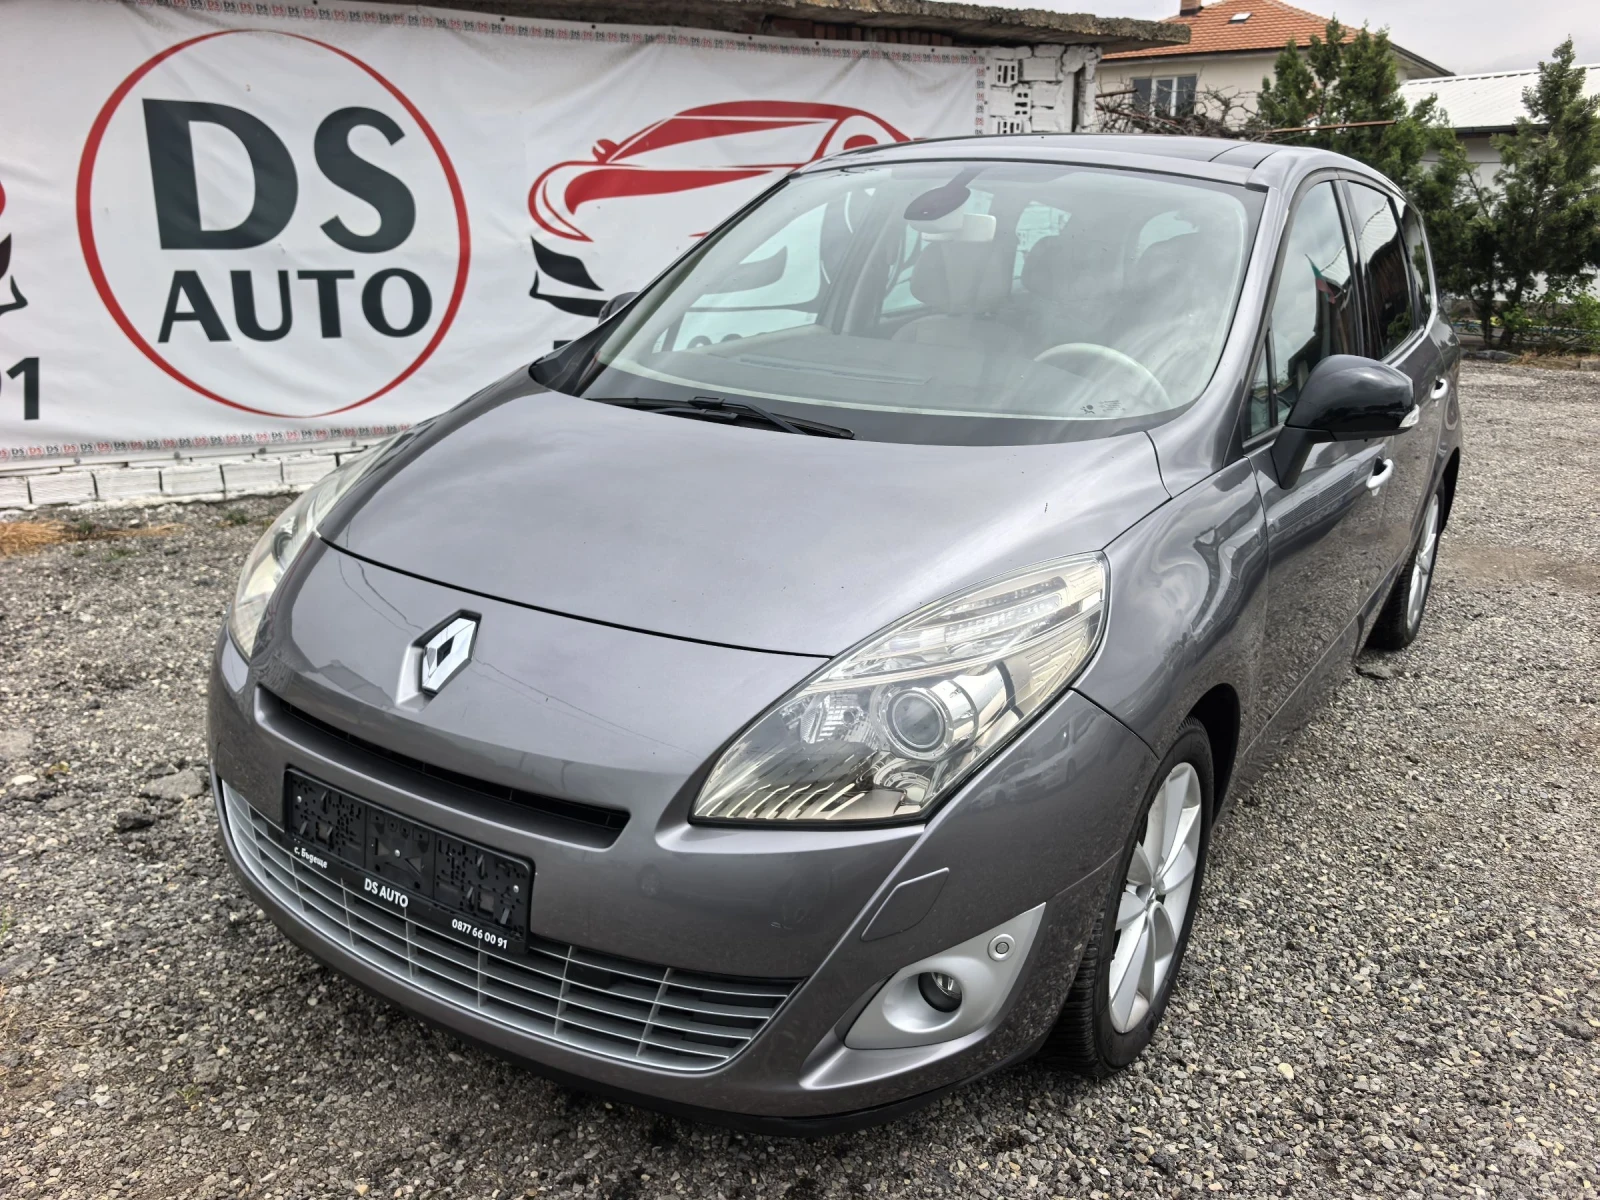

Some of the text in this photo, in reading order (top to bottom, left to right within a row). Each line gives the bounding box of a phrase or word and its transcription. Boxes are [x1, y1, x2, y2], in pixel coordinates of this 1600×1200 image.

[142, 98, 416, 254] DS
[158, 268, 432, 342] AUTO
[0, 357, 40, 420] 1
[301, 848, 328, 868] Бъдеще
[364, 878, 408, 908] DS AUTO
[452, 918, 508, 949] 0877 66 00 91
